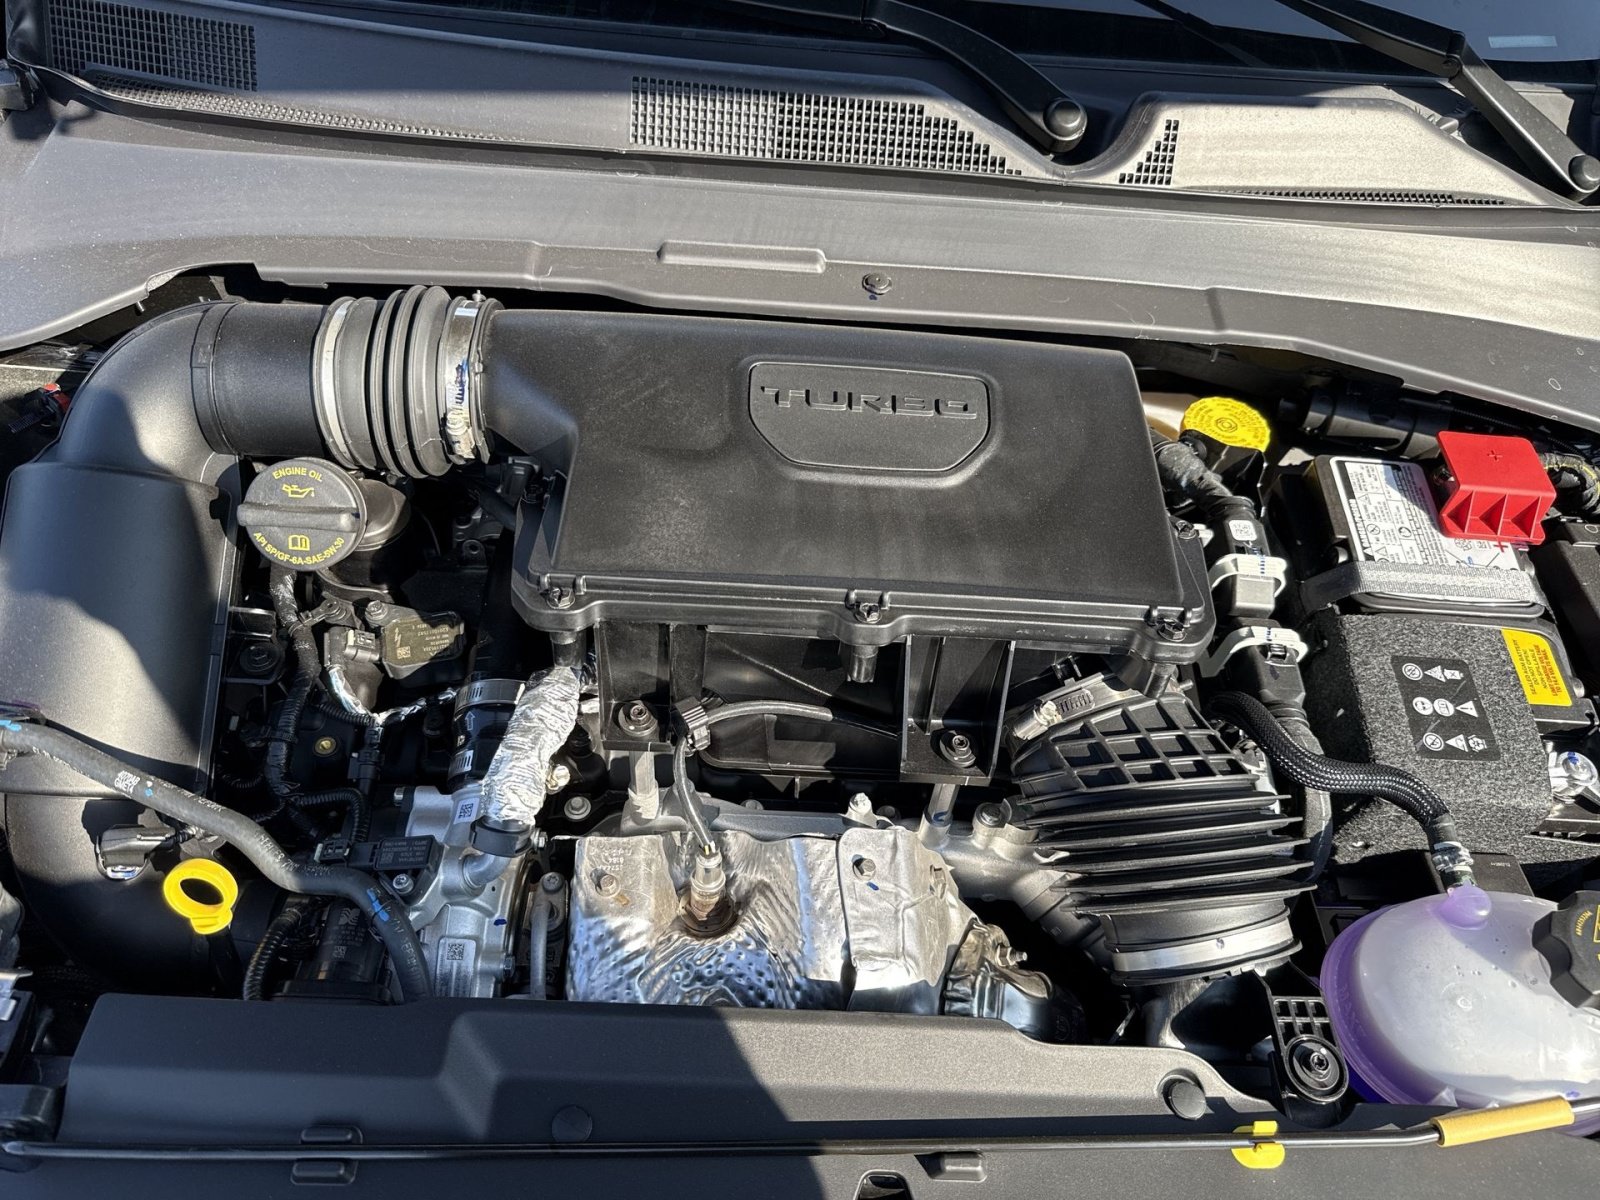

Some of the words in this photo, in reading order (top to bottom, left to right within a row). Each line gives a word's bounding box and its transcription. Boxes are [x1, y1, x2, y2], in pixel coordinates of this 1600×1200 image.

[760, 386, 977, 419] TURBO
[272, 467, 307, 480] ENGINE
[308, 470, 323, 482] OIL
[253, 532, 268, 548] API
[1512, 639, 1524, 662] BATTERY
[1520, 662, 1530, 675] AGM
[1525, 675, 1537, 695] SEALED
[1531, 676, 1539, 685] DO
